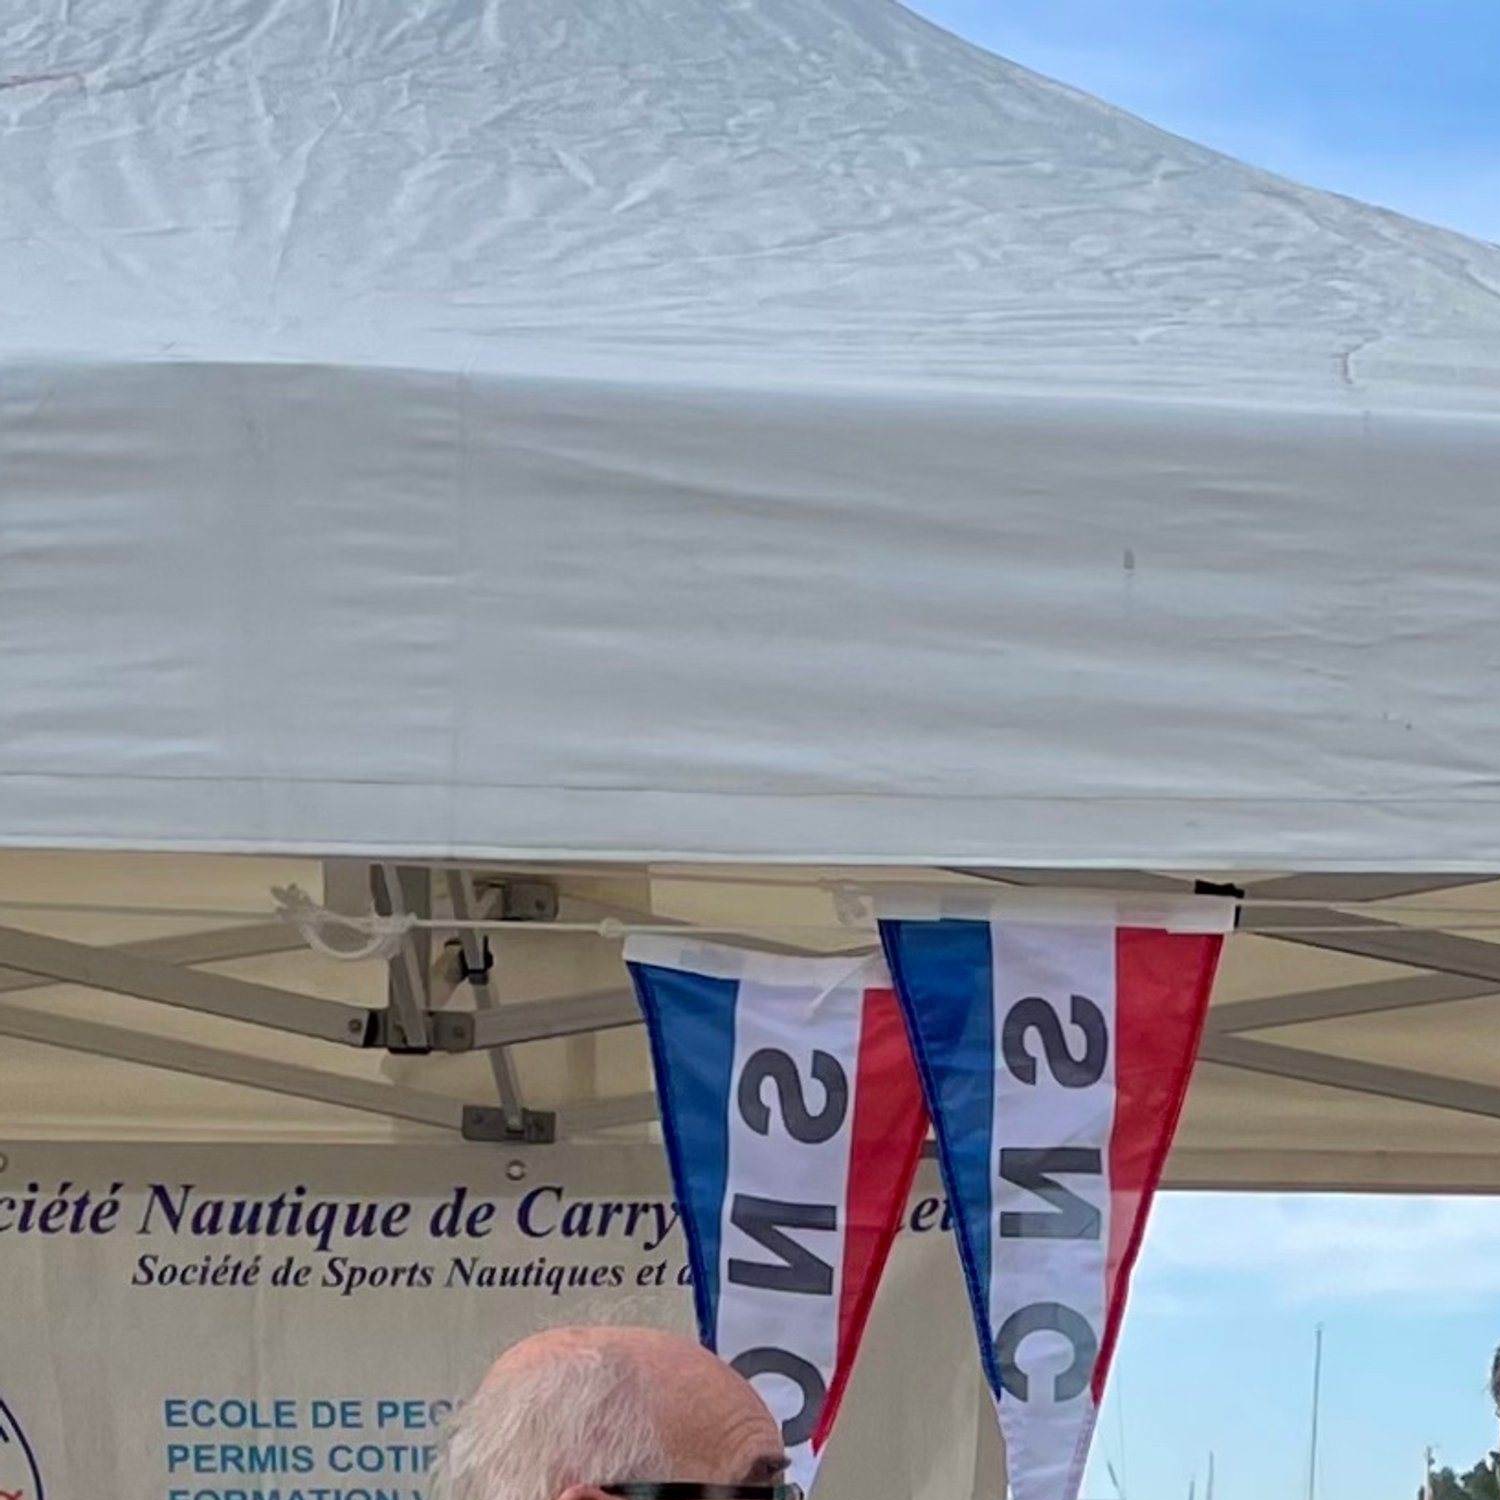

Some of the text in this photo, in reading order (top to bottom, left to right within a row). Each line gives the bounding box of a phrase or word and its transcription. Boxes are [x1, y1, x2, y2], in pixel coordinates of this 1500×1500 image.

[136, 1183, 410, 1252] Nautique
[430, 1186, 496, 1239] de
[517, 1185, 681, 1251] Carry
[132, 1254, 260, 1287] Société
[271, 1256, 311, 1287] de
[321, 1256, 434, 1296] Sports
[445, 1257, 625, 1295] Nautiques
[636, 1259, 667, 1286] et
[165, 1399, 462, 1429] ECOLE DE PEC
[168, 1444, 313, 1473] PERMIS
